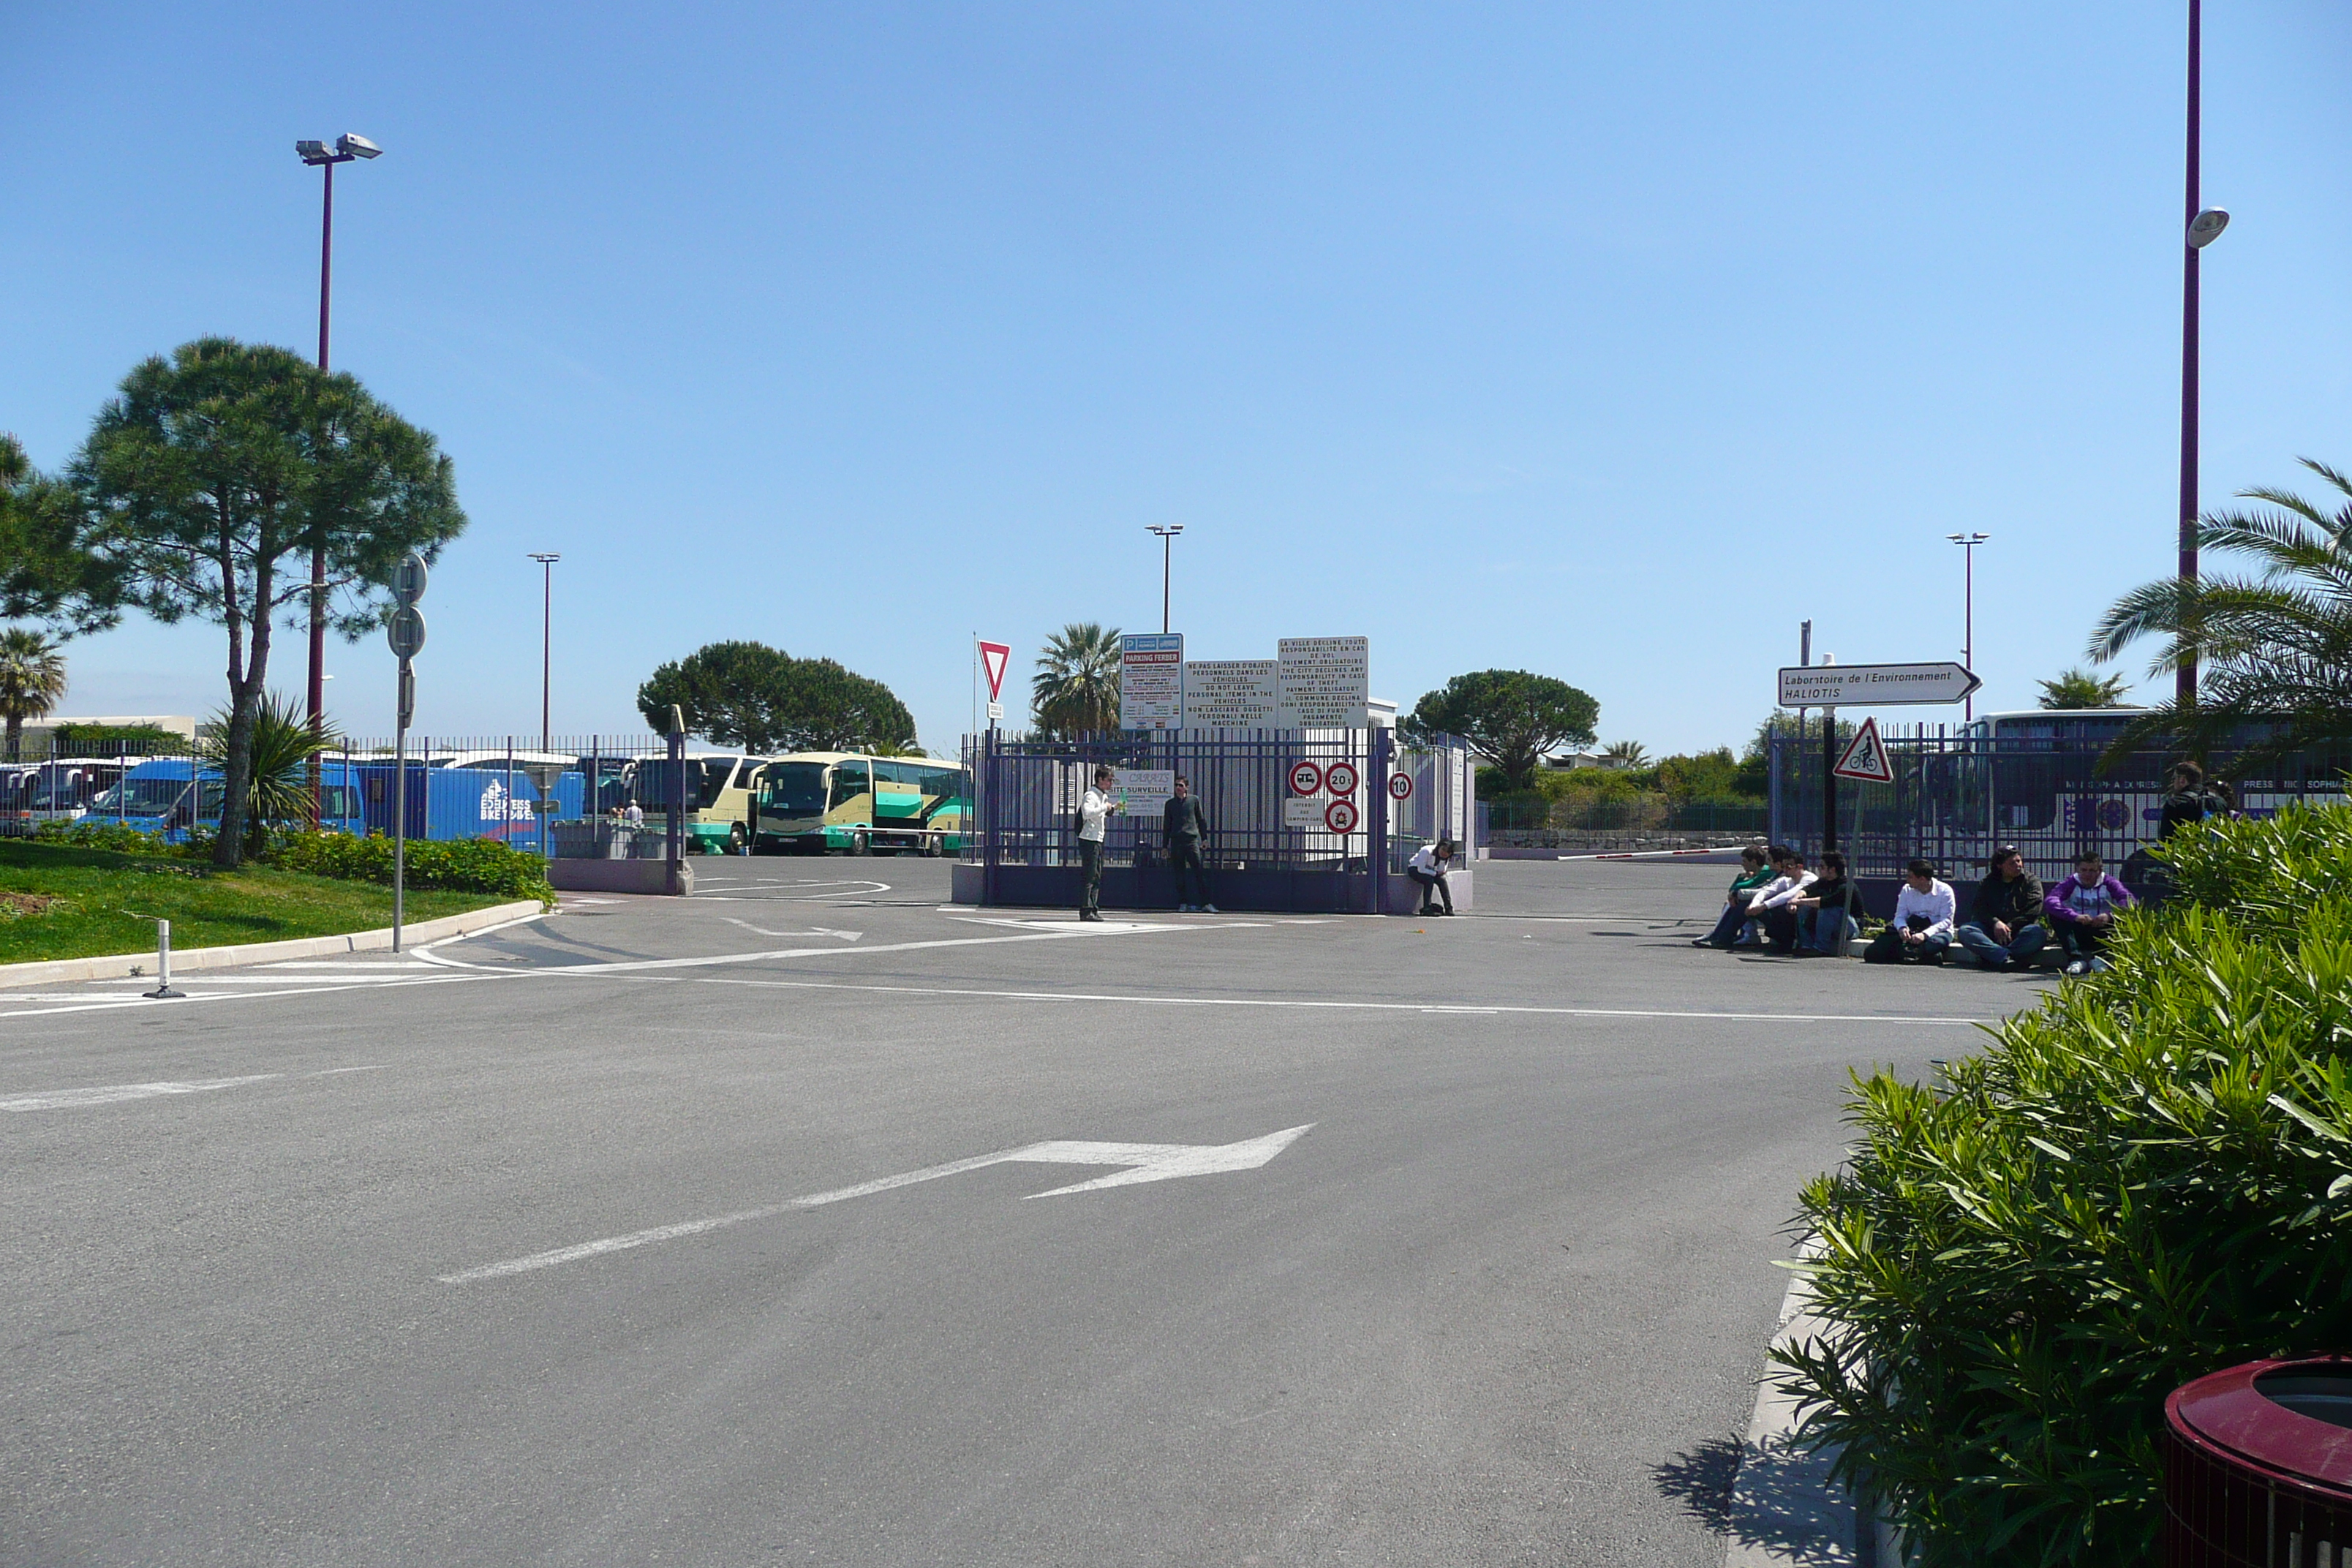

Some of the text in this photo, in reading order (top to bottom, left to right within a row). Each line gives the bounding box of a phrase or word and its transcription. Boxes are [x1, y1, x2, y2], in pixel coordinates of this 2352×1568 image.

[1126, 653, 1177, 663] PARKING FERBER
[1848, 674, 1861, 683] de
[1784, 688, 1841, 699] HALIOTIS
[1128, 773, 1169, 784] CARATS
[1332, 775, 1346, 785] 20
[1394, 780, 1407, 793] 10
